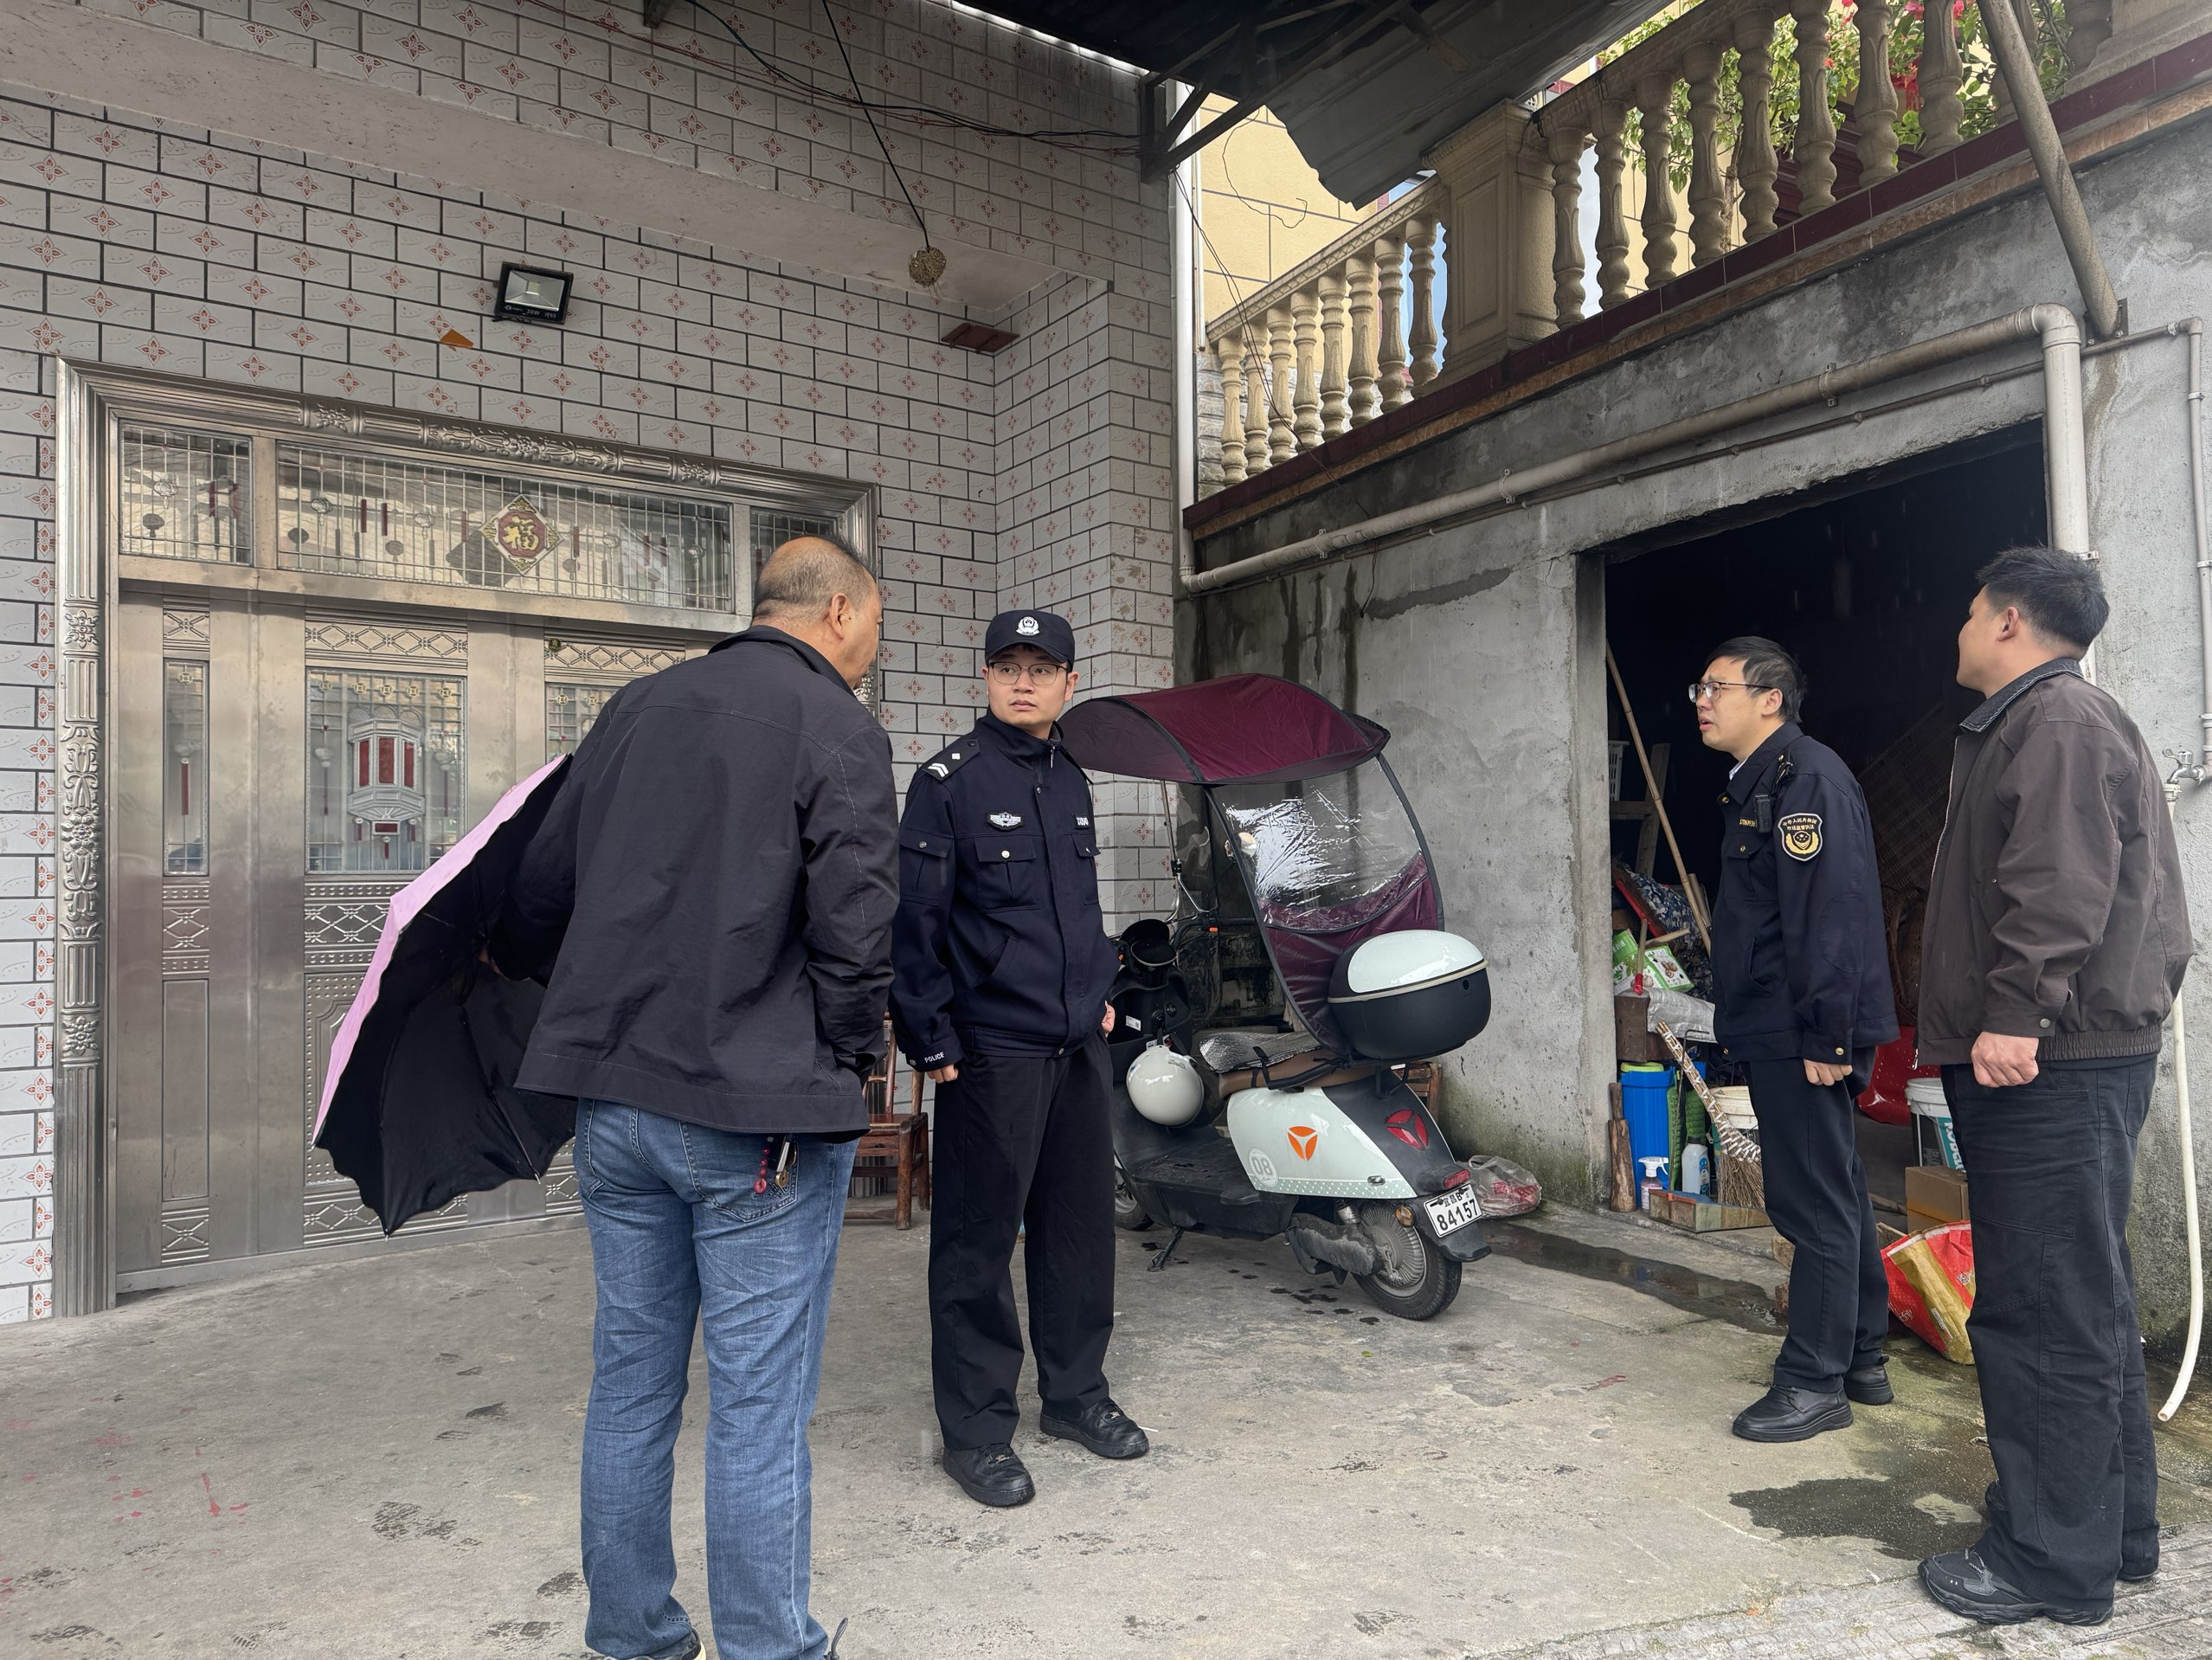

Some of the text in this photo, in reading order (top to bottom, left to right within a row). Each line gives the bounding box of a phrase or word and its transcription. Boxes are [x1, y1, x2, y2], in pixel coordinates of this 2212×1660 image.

[502, 514, 539, 551] 福
[924, 1052, 945, 1064] POLICE
[1251, 1156, 1274, 1175] 08
[1444, 1193, 1463, 1207] 宜昌B
[1437, 1199, 1478, 1232] 84157
